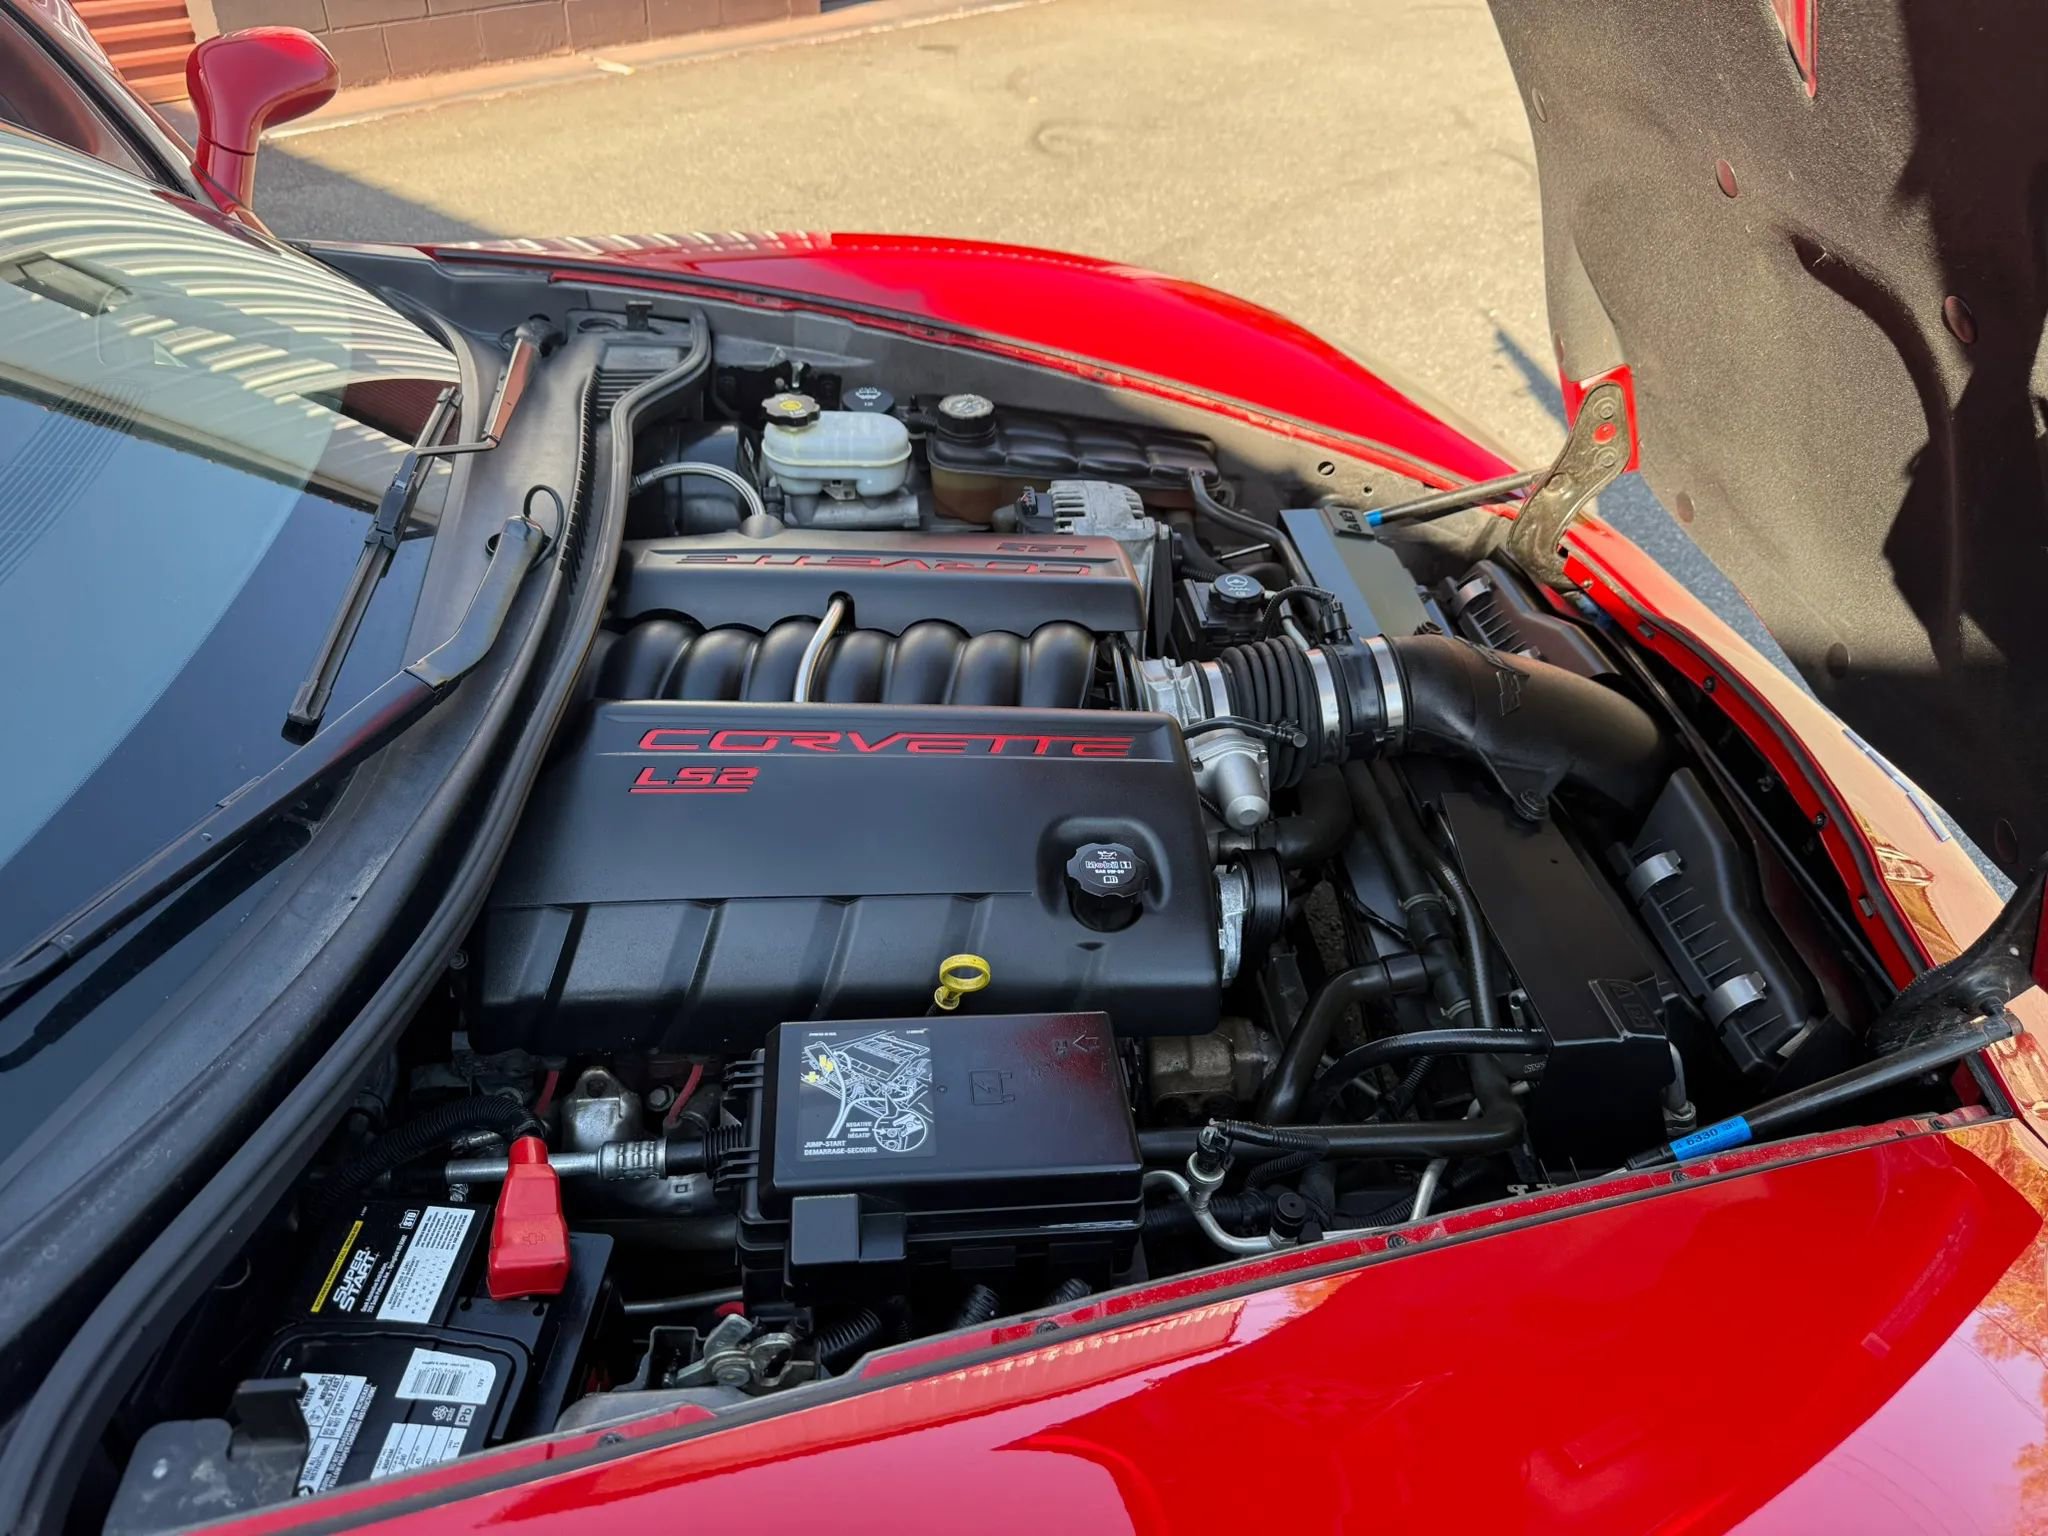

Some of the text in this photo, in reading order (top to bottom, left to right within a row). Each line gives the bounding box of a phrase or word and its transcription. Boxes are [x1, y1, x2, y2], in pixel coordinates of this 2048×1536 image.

[675, 555, 1091, 576] CORVETTE
[638, 728, 1135, 758] CORVETTE
[632, 766, 760, 790] LS2
[1085, 861, 1119, 869] Mobil
[804, 1140, 847, 1148] JUMP-START
[331, 1249, 368, 1303] SUPER
[338, 1251, 379, 1311] START
[458, 1407, 473, 1423] Pb
